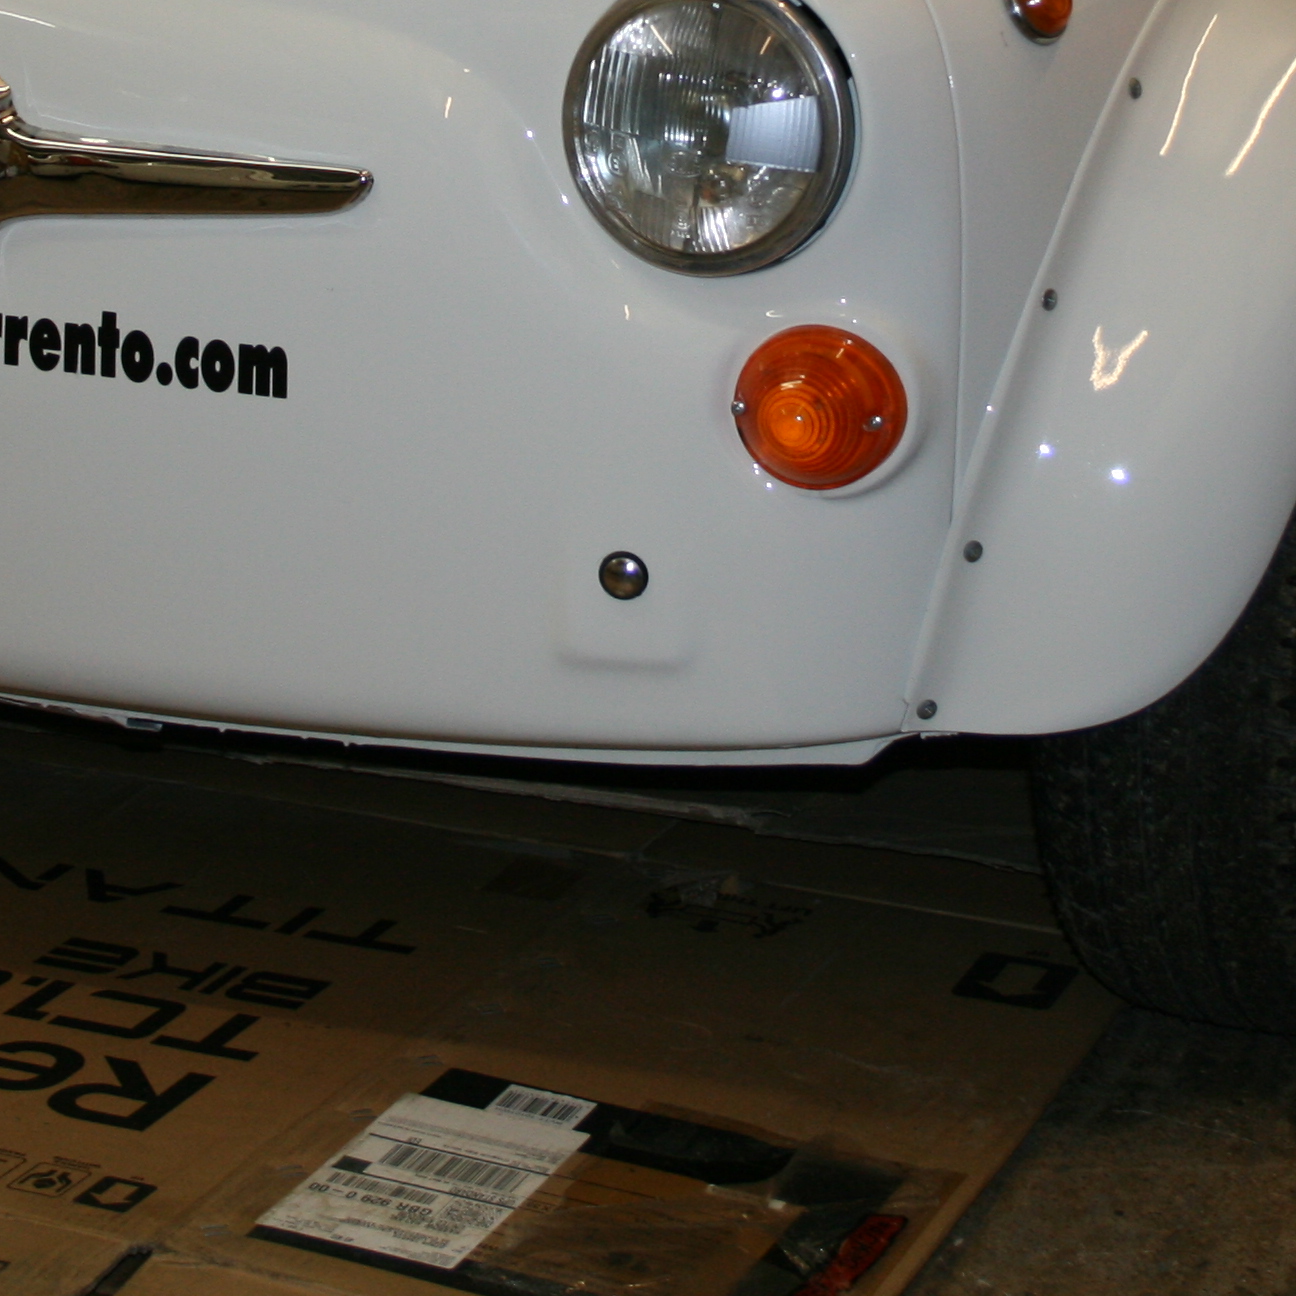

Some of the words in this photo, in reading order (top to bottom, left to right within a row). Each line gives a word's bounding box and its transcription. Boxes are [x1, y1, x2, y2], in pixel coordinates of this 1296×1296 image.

[33, 936, 333, 1010] BIKE
[360, 1194, 392, 1207] 929
[395, 1203, 433, 1216] GBR
